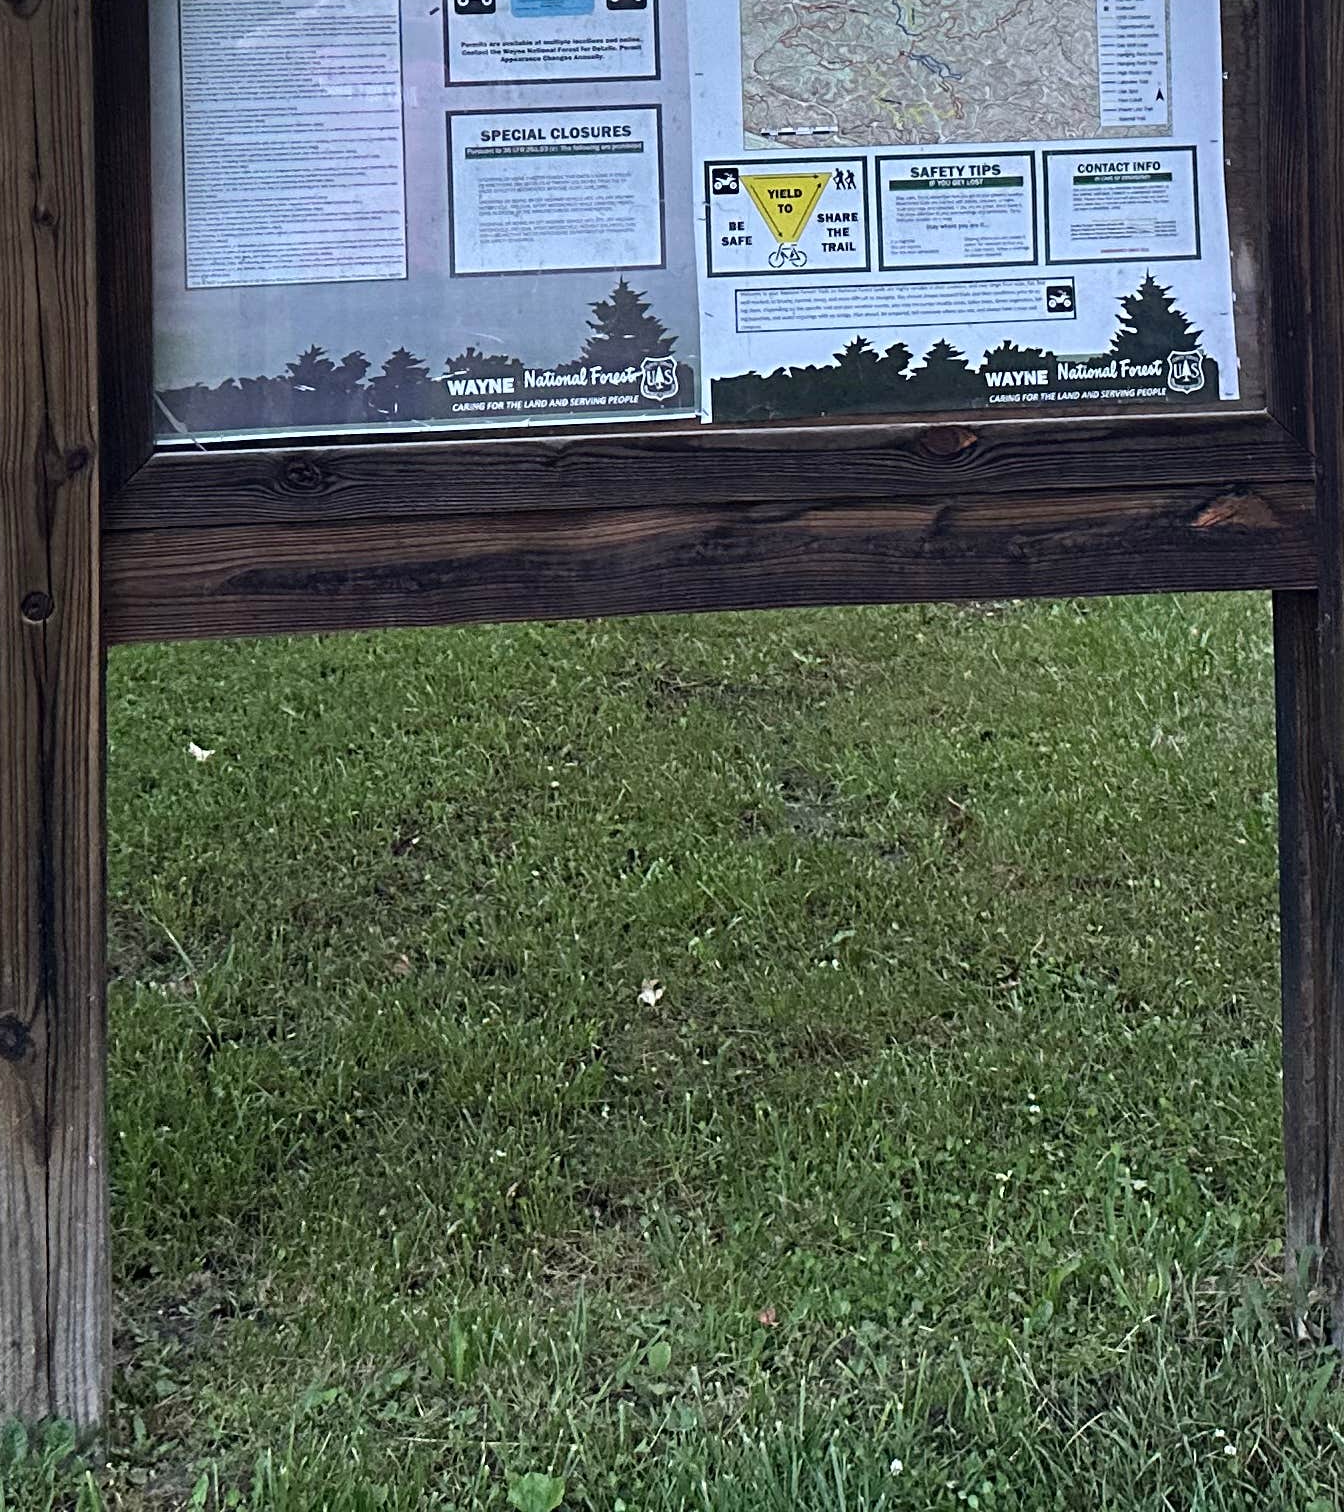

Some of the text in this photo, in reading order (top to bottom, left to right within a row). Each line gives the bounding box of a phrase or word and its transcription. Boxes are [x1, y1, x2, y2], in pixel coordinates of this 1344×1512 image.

[480, 125, 632, 142] SPECIAL CLOSURES
[910, 164, 1001, 178] SAFETY TIPS
[1077, 160, 1168, 174] CONTACT INFO
[767, 188, 803, 199] YIELD
[777, 203, 793, 214] TO
[817, 212, 859, 223] SHARE
[728, 221, 745, 231] BE
[826, 227, 849, 238] THE
[721, 235, 753, 247] SAFE
[821, 241, 856, 253] TRAIL
[985, 358, 1163, 387] WAYNE National Forest
[447, 365, 637, 396] WAYNE National Forest
[989, 387, 1167, 403] CARING FOR THE LAND AND SERVING PEOPLE
[452, 394, 639, 412] CARING FOR THE LAND AND SERVING PEOPLE
